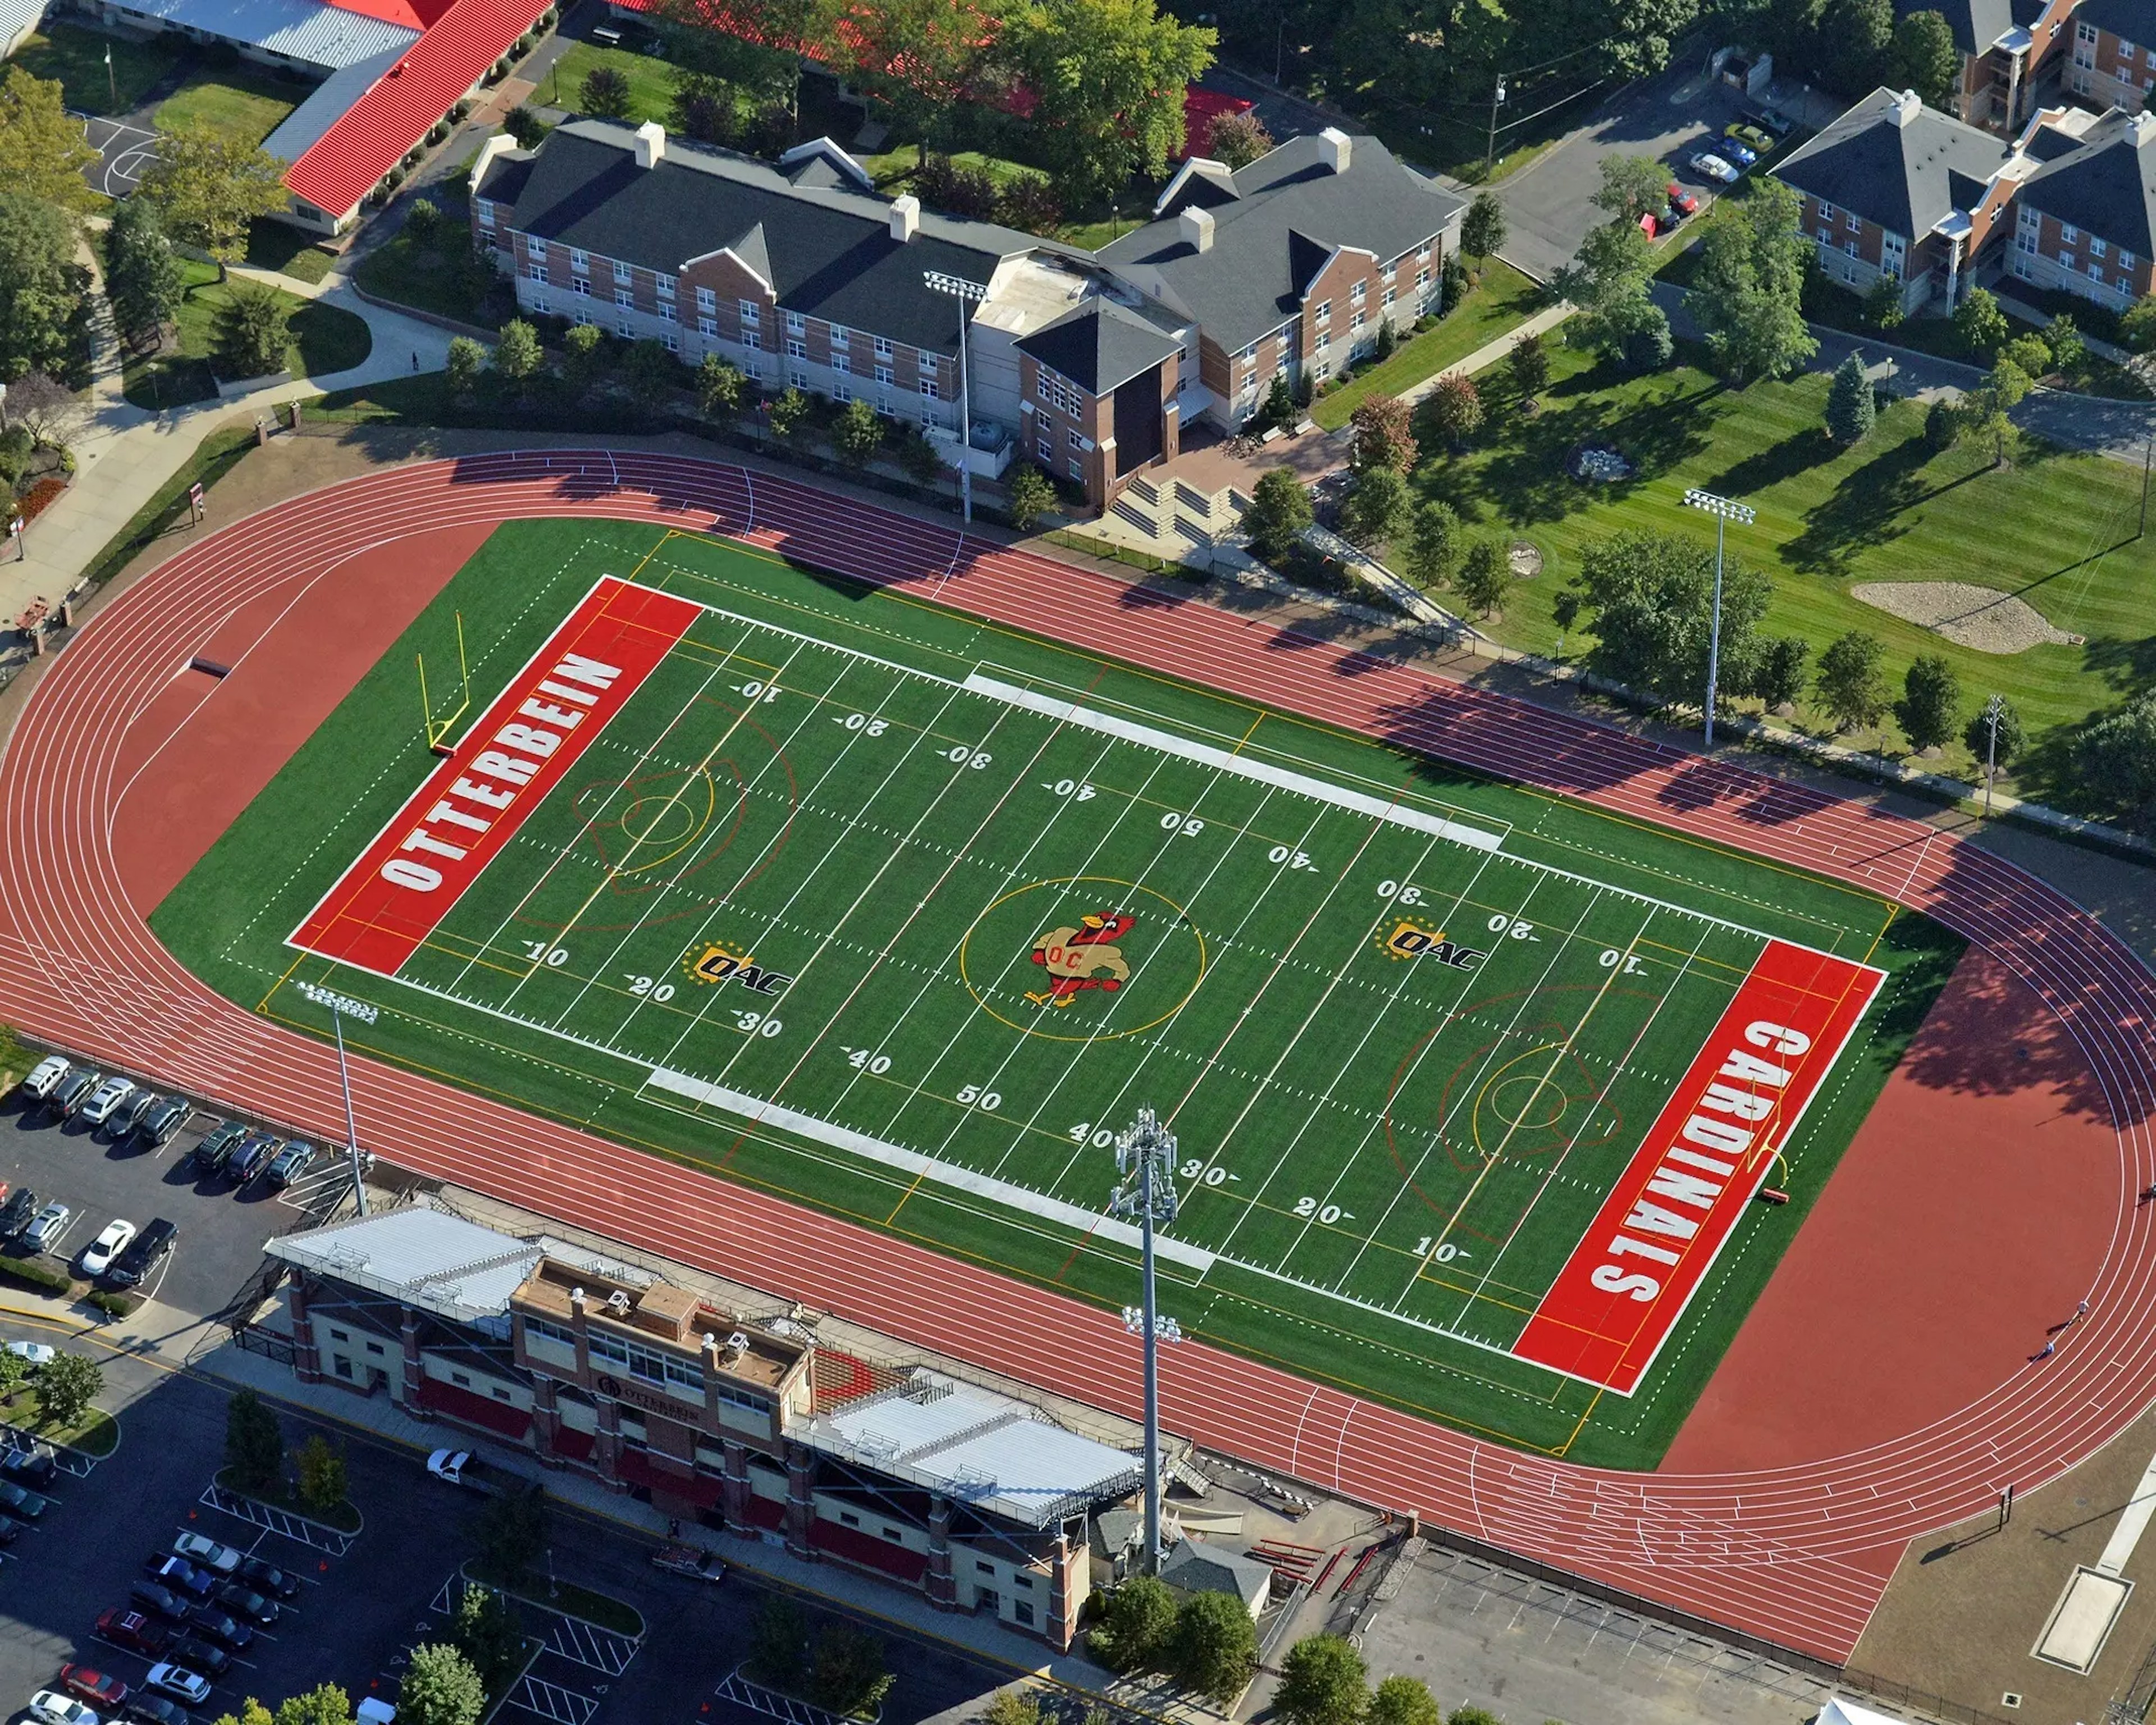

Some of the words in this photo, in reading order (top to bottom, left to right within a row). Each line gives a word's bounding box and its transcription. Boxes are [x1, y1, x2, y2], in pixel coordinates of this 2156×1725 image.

[742, 681, 783, 703] 10
[845, 714, 890, 737] 20
[948, 746, 992, 770] 30
[381, 653, 623, 892] OTTERBEIN
[1054, 779, 1097, 802] 40
[1161, 812, 1205, 837] 50
[1269, 846, 1310, 870] 40
[1377, 880, 1423, 906] 30
[1488, 914, 1534, 941] 20
[526, 942, 569, 967] 10
[1049, 946, 1083, 969] OC
[1392, 930, 1488, 971] OAC
[1598, 950, 1643, 975] 10
[628, 976, 675, 1002] 20
[698, 955, 793, 997] OAC
[737, 1012, 783, 1038] 30
[848, 1049, 892, 1075] 40
[956, 1084, 1002, 1111] 50
[1069, 1122, 1114, 1148] 40
[1180, 1158, 1226, 1186] 30
[1591, 1020, 1811, 1302] CARDINALS
[1292, 1196, 1341, 1224] 20
[1412, 1236, 1456, 1263] 10
